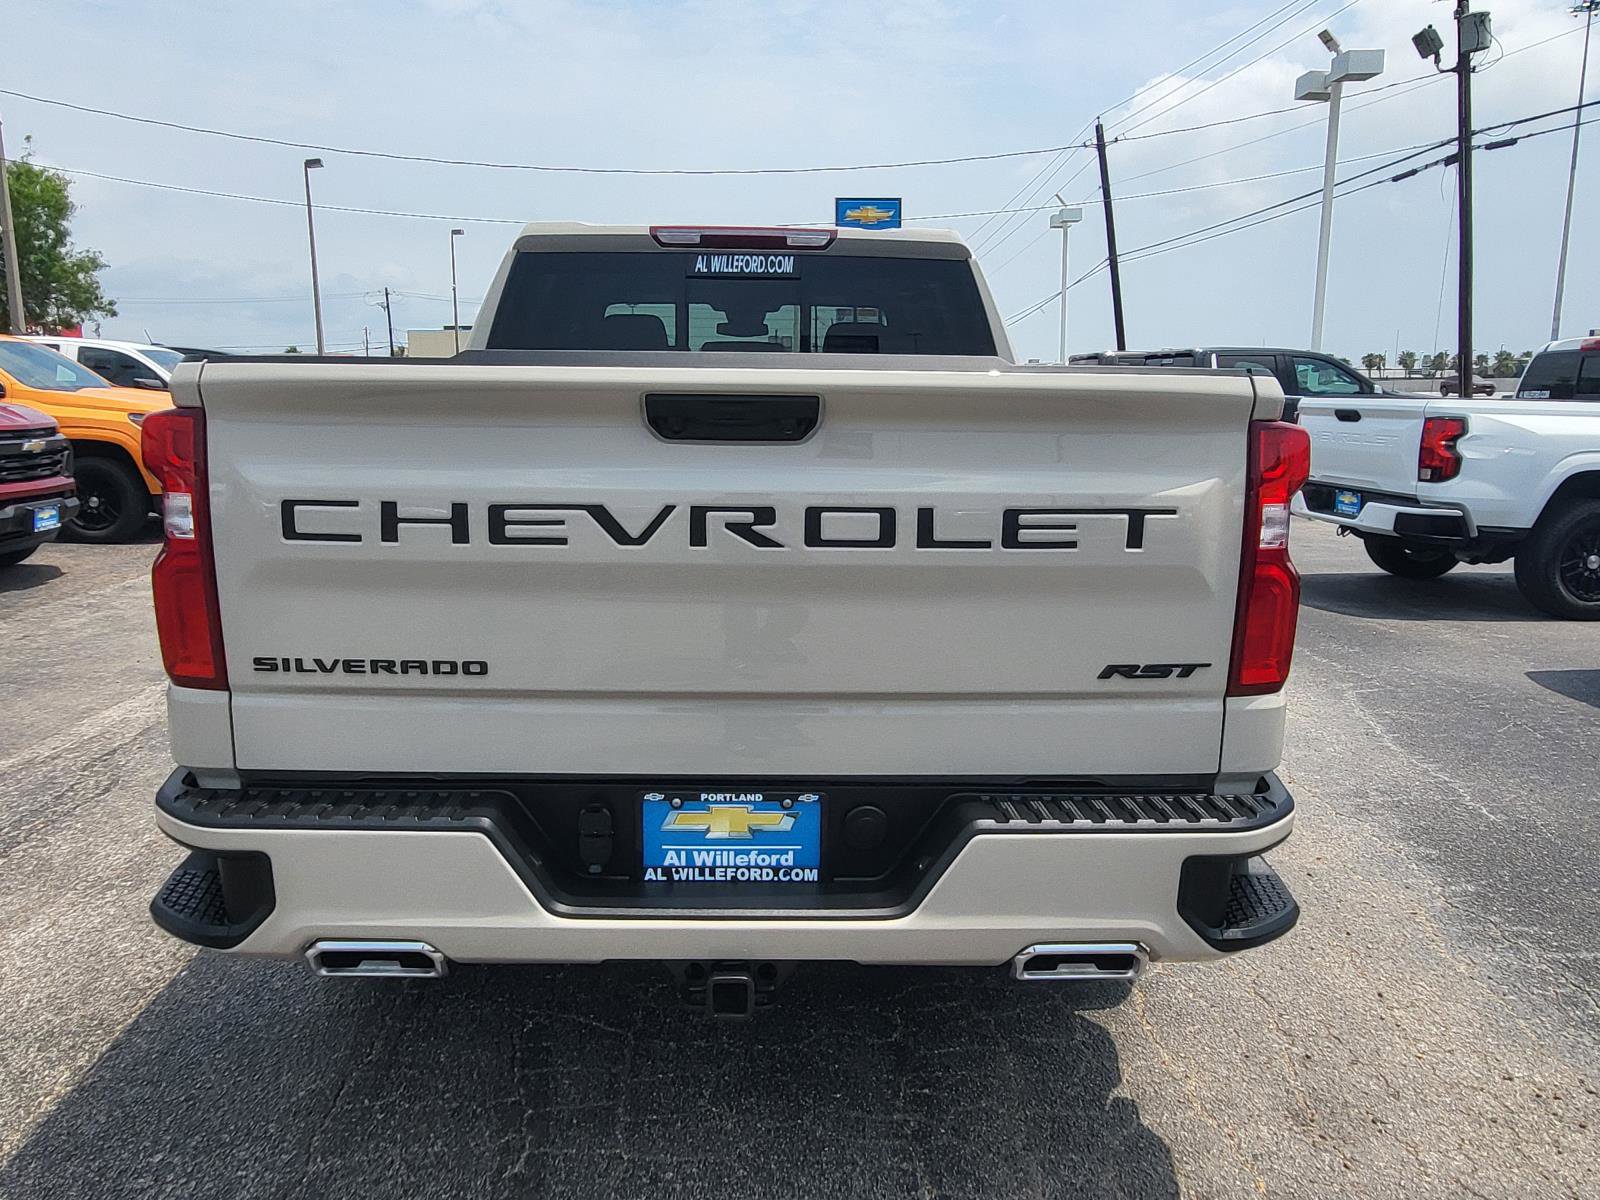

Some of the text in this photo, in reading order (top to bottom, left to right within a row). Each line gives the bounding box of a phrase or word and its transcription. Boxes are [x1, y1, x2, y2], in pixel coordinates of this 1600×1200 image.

[695, 255, 794, 274] AL WILLEFORD.COM
[281, 498, 1178, 552] CHEVROLET
[252, 656, 489, 676] SILVERADO
[1096, 662, 1213, 679] RST
[700, 793, 764, 802] PORTLAND
[663, 850, 794, 867] Al Willeford
[643, 867, 819, 882] AL WILLEFORD.COM
